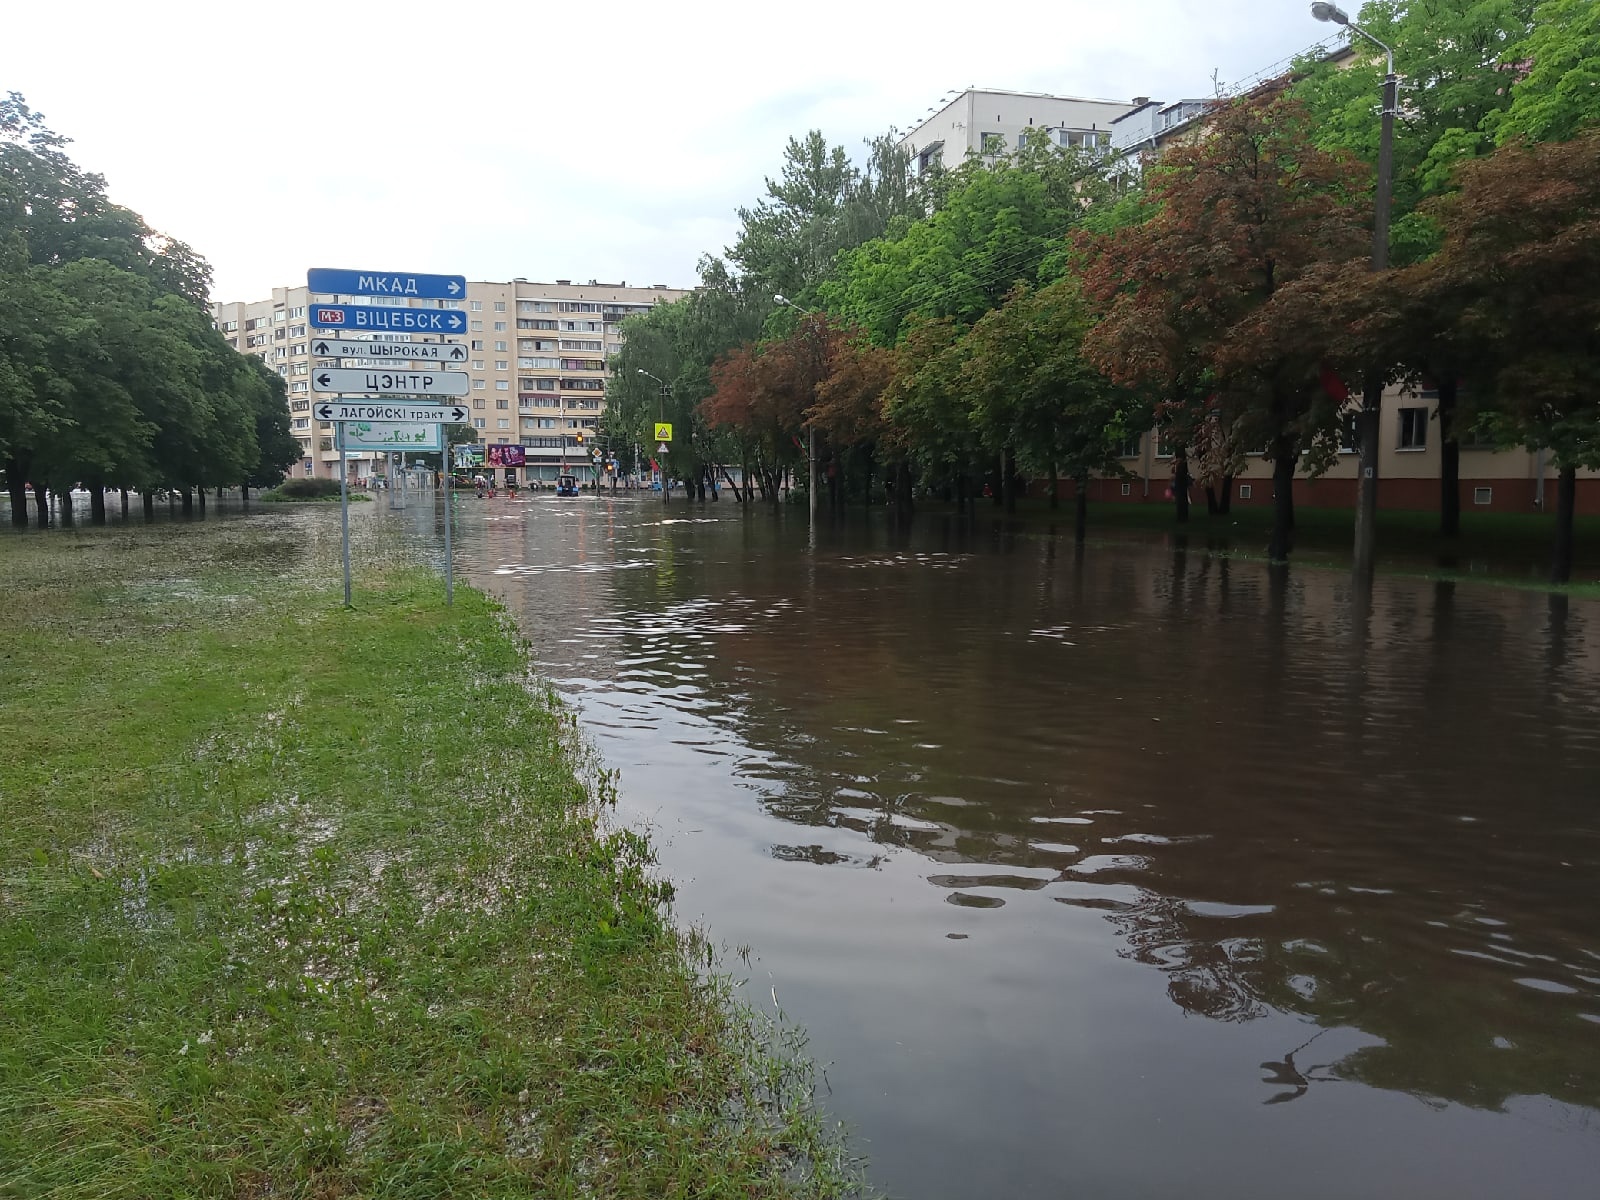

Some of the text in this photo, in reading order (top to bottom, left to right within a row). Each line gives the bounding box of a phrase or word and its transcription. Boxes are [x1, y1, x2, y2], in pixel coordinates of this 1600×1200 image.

[358, 276, 418, 294] МКАД
[321, 311, 442, 329] М-3 ВІЦЕБСК
[342, 345, 438, 357] вул. ШЫРОКАЯ
[366, 374, 433, 391] ЦЭНТР
[339, 406, 444, 421] ЛАГОЙСКІ тракт
